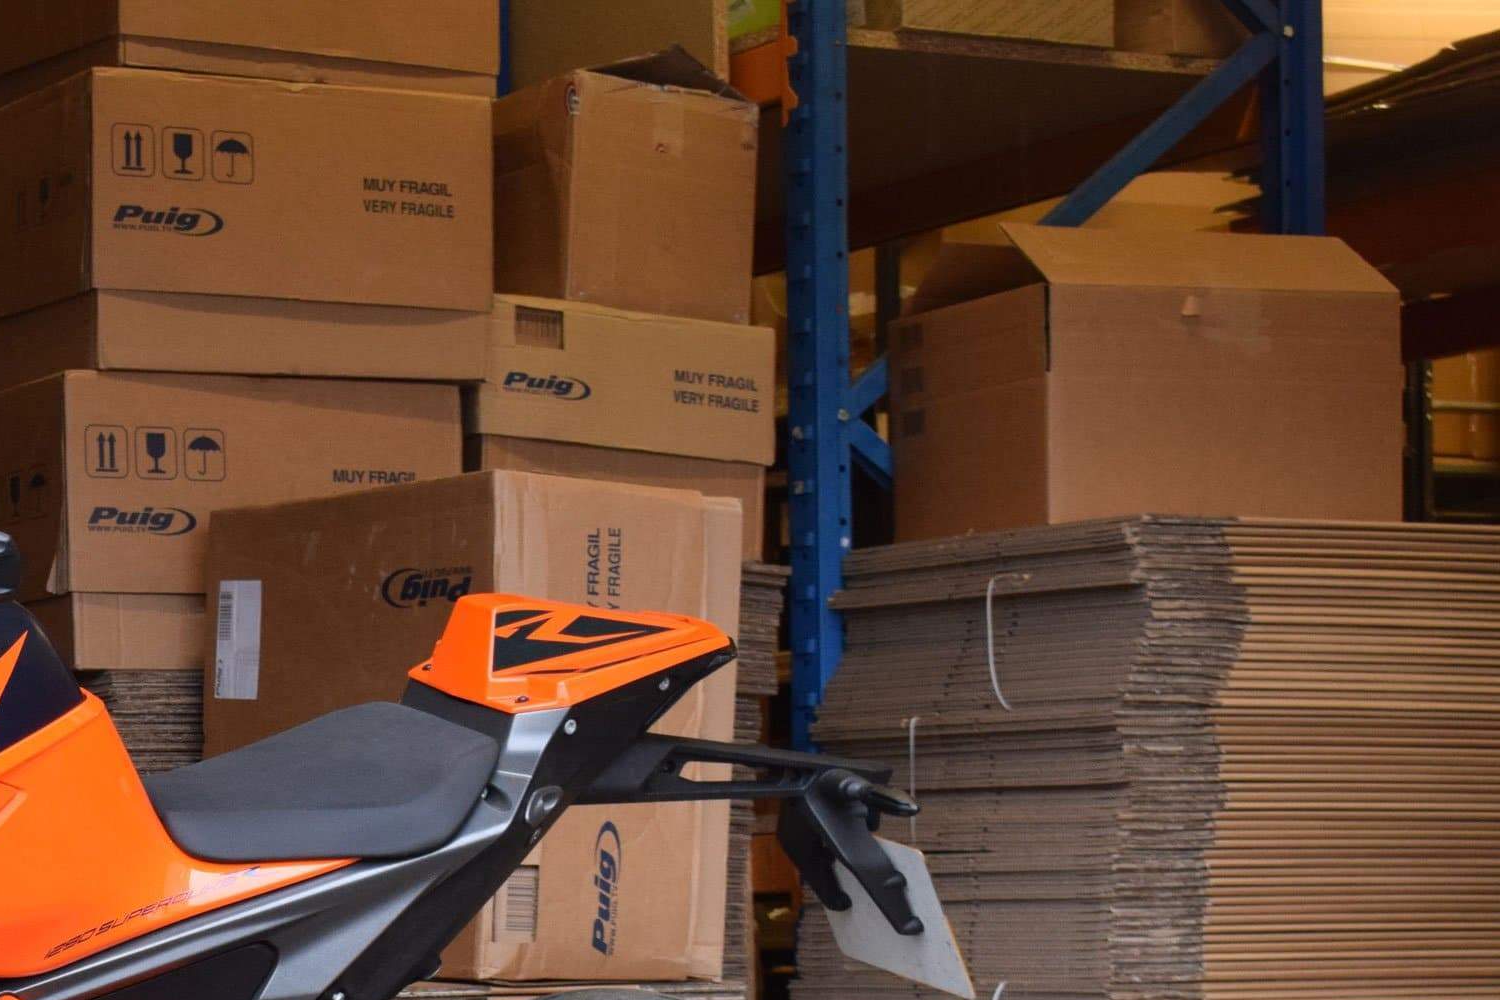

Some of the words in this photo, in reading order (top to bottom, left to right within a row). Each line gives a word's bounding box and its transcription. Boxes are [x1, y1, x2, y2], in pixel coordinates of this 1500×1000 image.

[363, 178, 396, 193] MUY
[399, 180, 453, 197] FRAGIL
[113, 205, 201, 232] Puig
[363, 200, 397, 213] VERY
[400, 201, 455, 218] FRAGILE
[503, 371, 574, 395] Puig
[674, 370, 704, 384] MUY
[707, 373, 758, 392] FRAGIL
[674, 389, 705, 405] VERY
[707, 393, 759, 413] FRAGILE
[332, 469, 364, 483] MUY
[87, 506, 175, 532] Puig
[586, 528, 601, 596] FRAGIL
[607, 528, 622, 597] FRAGILE
[591, 849, 617, 956] Puig
